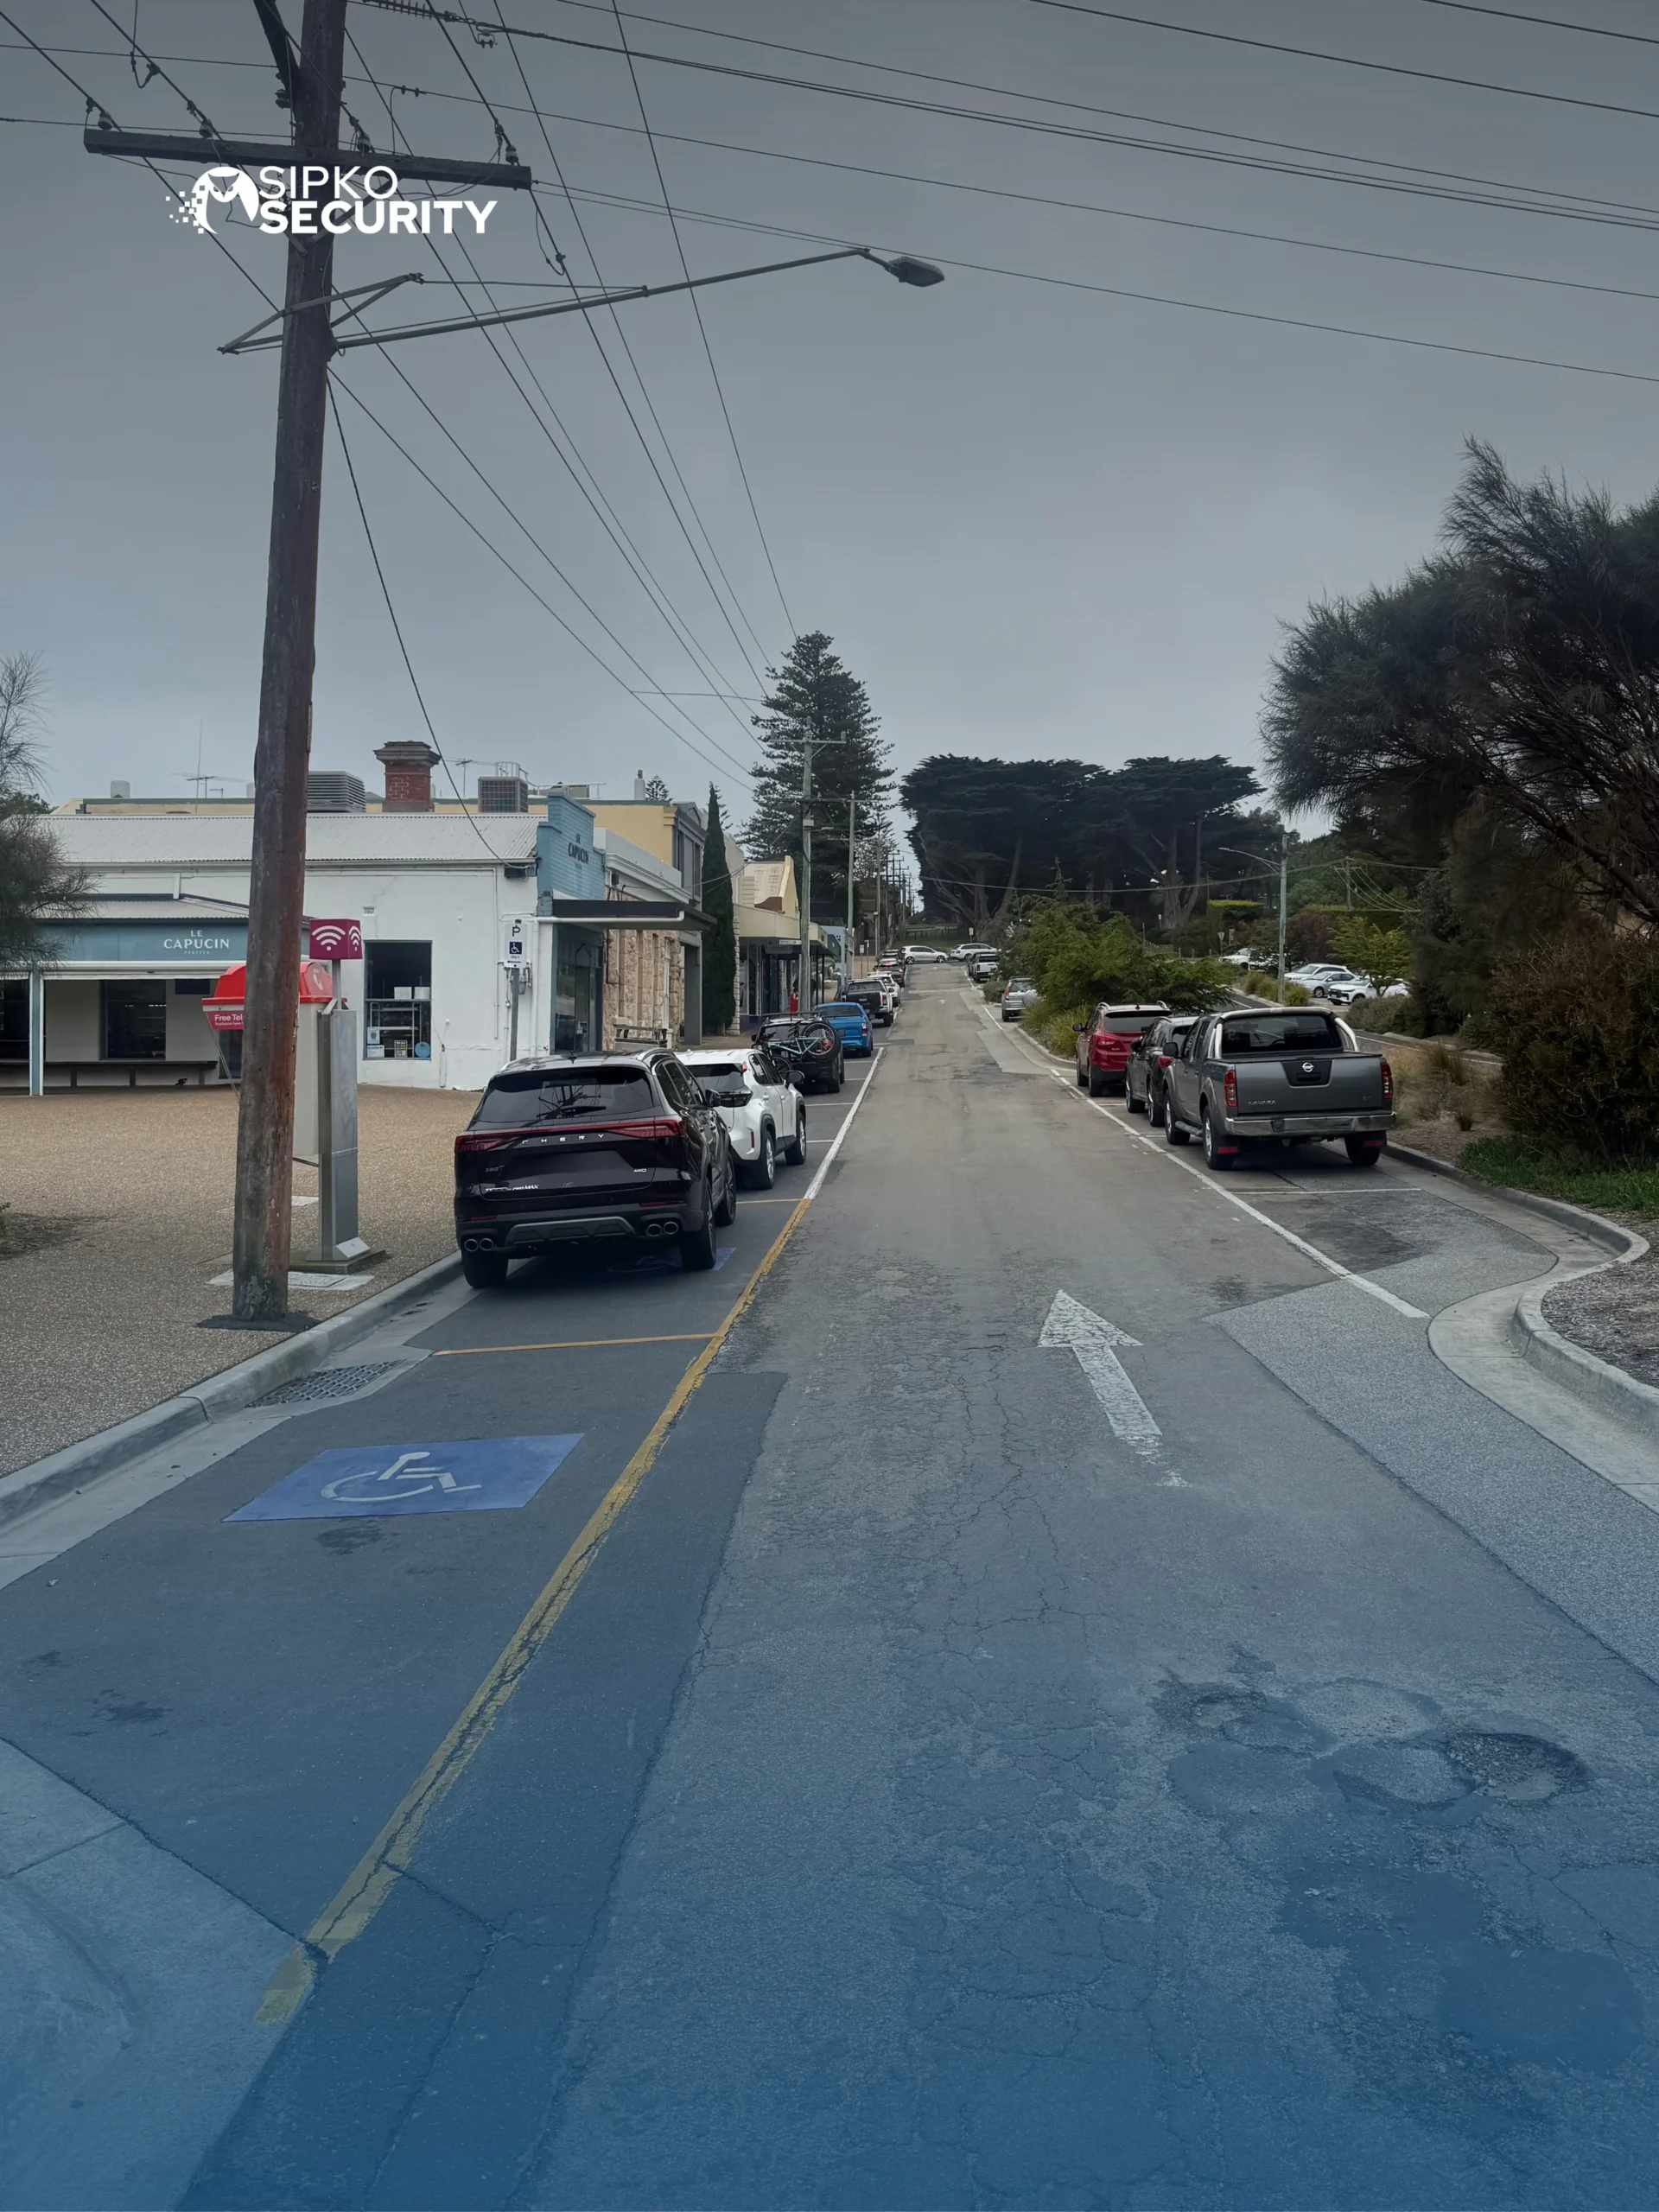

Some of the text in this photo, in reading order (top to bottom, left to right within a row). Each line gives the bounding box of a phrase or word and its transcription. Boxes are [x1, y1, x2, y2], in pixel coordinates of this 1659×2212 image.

[512, 925, 521, 937] P
[163, 938, 230, 949] CAPUCIN
[522, 1133, 604, 1145] CHERY
